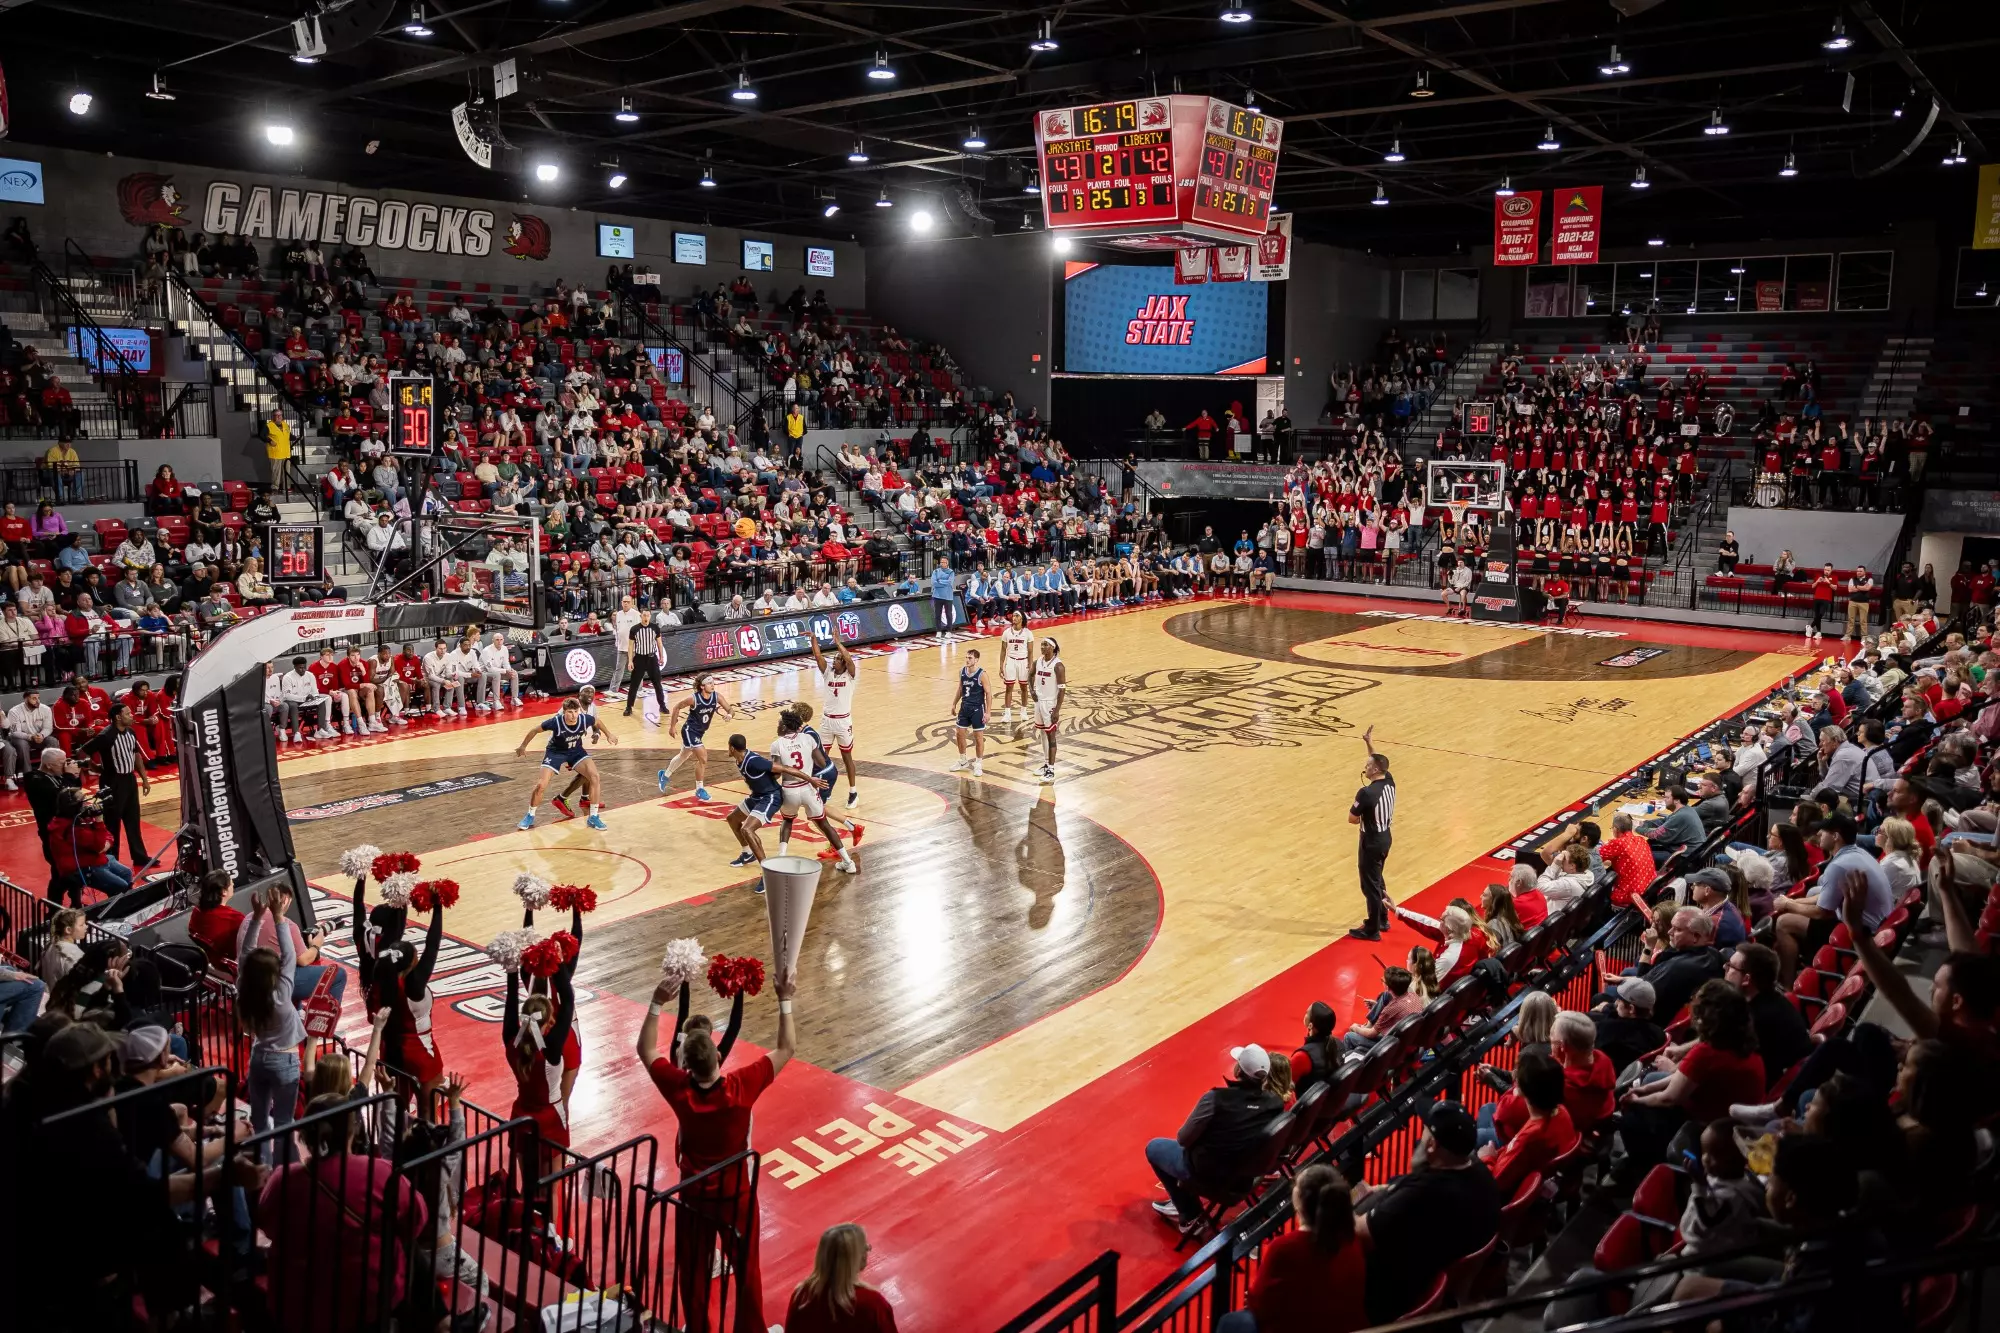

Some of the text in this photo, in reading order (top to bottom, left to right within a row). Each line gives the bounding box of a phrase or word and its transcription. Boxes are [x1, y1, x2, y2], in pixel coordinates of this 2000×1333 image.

[1084, 104, 1135, 133] 16:19
[1233, 111, 1264, 140] 16:19
[1124, 132, 1163, 147] LIBERTY
[1047, 140, 1092, 155] JAXSTATE
[1095, 143, 1118, 153] PERIOD
[1252, 145, 1274, 161] LIBERTY
[1102, 154, 1113, 174] 2
[1142, 147, 1168, 172] 42
[1208, 151, 1225, 176] 43
[1055, 156, 1081, 180] 43
[1235, 160, 1243, 179] 2
[1087, 178, 1131, 189] PLAYER FOUL
[1151, 175, 1172, 184] FOULS
[1179, 179, 1196, 187] JSU
[1258, 165, 1273, 189] 42
[1048, 184, 1068, 193] FOULS
[1166, 186, 1171, 202] 1
[1062, 195, 1067, 210] 1
[1076, 196, 1083, 210] 3
[1091, 189, 1129, 209] 25 1
[1138, 191, 1146, 205] 3
[1213, 193, 1219, 208] 3
[1223, 192, 1237, 212] 25
[1249, 201, 1255, 216] 3
[1508, 203, 1526, 211] OVC
[202, 181, 496, 257] GAMECOCKS
[1501, 218, 1534, 227] CHAMPIONS
[1560, 215, 1593, 224] CHAMPIONS
[1501, 233, 1533, 245] 2016-17
[1557, 231, 1595, 243] 2021-22
[1264, 240, 1279, 253] 12
[1567, 244, 1583, 252] NCAA
[1556, 251, 1593, 260] TOURNAMENT
[1136, 294, 1191, 320] JAX
[1125, 319, 1196, 345] STATE
[403, 408, 428, 446] 30
[1470, 415, 1488, 432] 30
[282, 552, 307, 574] 30
[297, 625, 326, 638] Cooper
[773, 624, 799, 639] 16:19
[814, 619, 833, 641] 42
[708, 630, 729, 647] JAX
[740, 629, 761, 652] 43
[783, 641, 798, 650] 2ND
[706, 644, 734, 660] STATE
[1041, 677, 1046, 686] 5
[833, 688, 838, 697] 4
[965, 687, 971, 697] 3
[702, 714, 709, 724] 0
[790, 751, 804, 770] 3
[203, 708, 240, 879] cooperchevrolet.com
[759, 1102, 917, 1190] PETE
[878, 1119, 989, 1177] THE
